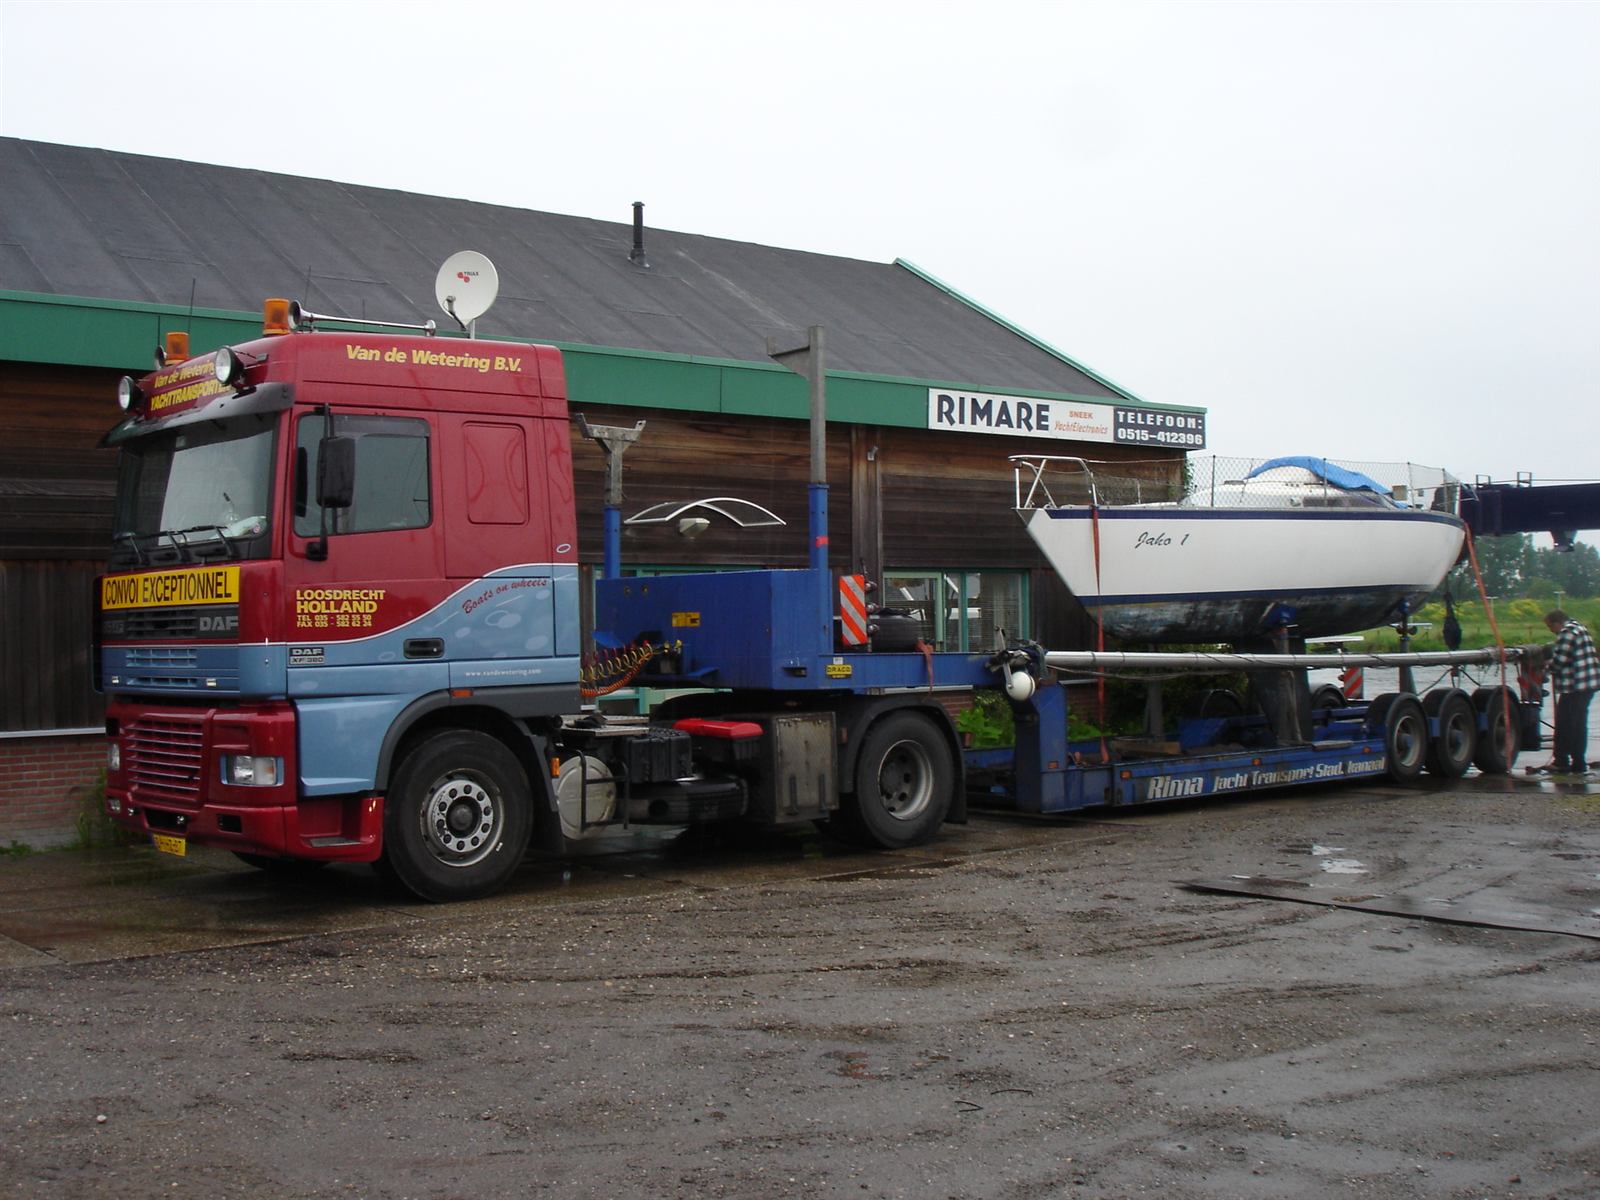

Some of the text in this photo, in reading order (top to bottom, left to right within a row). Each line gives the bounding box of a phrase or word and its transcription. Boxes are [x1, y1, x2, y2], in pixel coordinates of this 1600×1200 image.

[346, 345, 522, 373] Van de Wetering B.V.
[937, 394, 1050, 432] RIMARE
[1069, 411, 1094, 419] SNEEK
[1117, 411, 1203, 429] TELEFOON:
[1117, 428, 1203, 445] 0515-412396
[1134, 531, 1172, 549] Jako
[105, 571, 232, 605] CONVOI EXCEPTIONNEL
[296, 590, 386, 600] LOOSDRECHT
[296, 601, 378, 613] HOLLAND
[462, 590, 493, 614] Boats
[496, 584, 508, 594] on
[199, 616, 239, 631] DAF
[1147, 775, 1204, 800] Rima
[1212, 773, 1249, 793] Jacht
[1251, 766, 1314, 785] Transport
